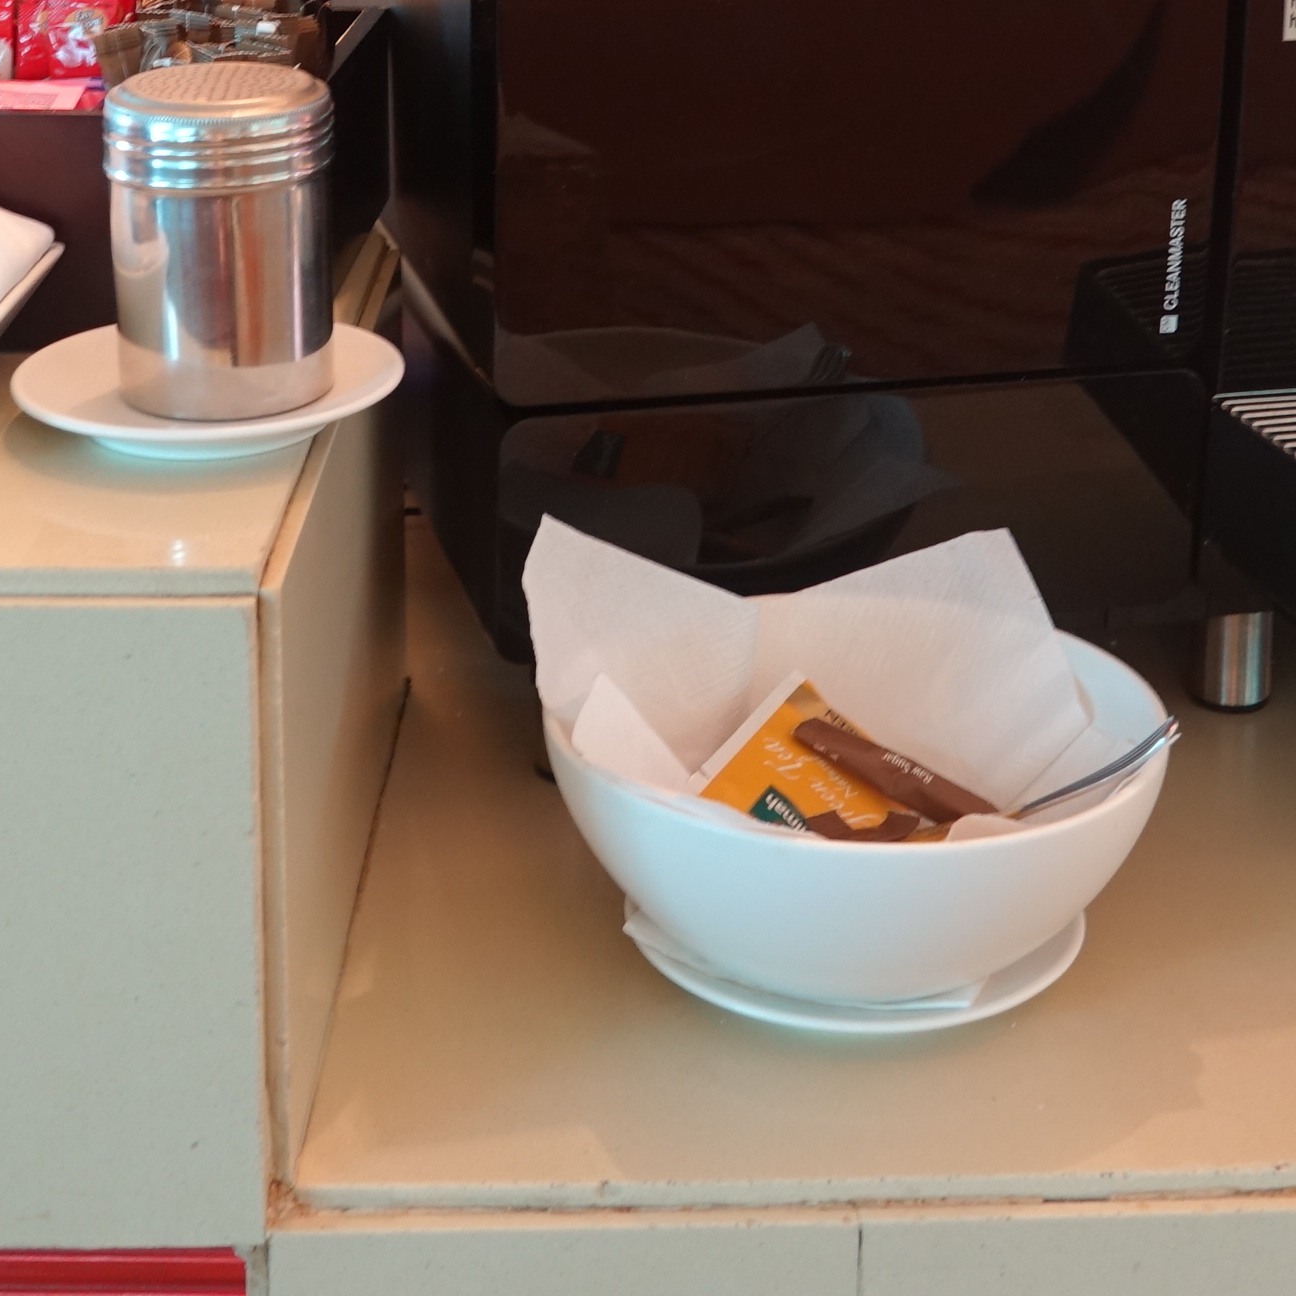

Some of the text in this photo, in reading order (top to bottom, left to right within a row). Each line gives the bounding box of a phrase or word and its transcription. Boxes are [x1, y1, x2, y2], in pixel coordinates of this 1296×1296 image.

[1163, 198, 1188, 311] CLEANMASTER
[762, 737, 814, 781] Tea
[881, 751, 935, 785] Raw Sugar
